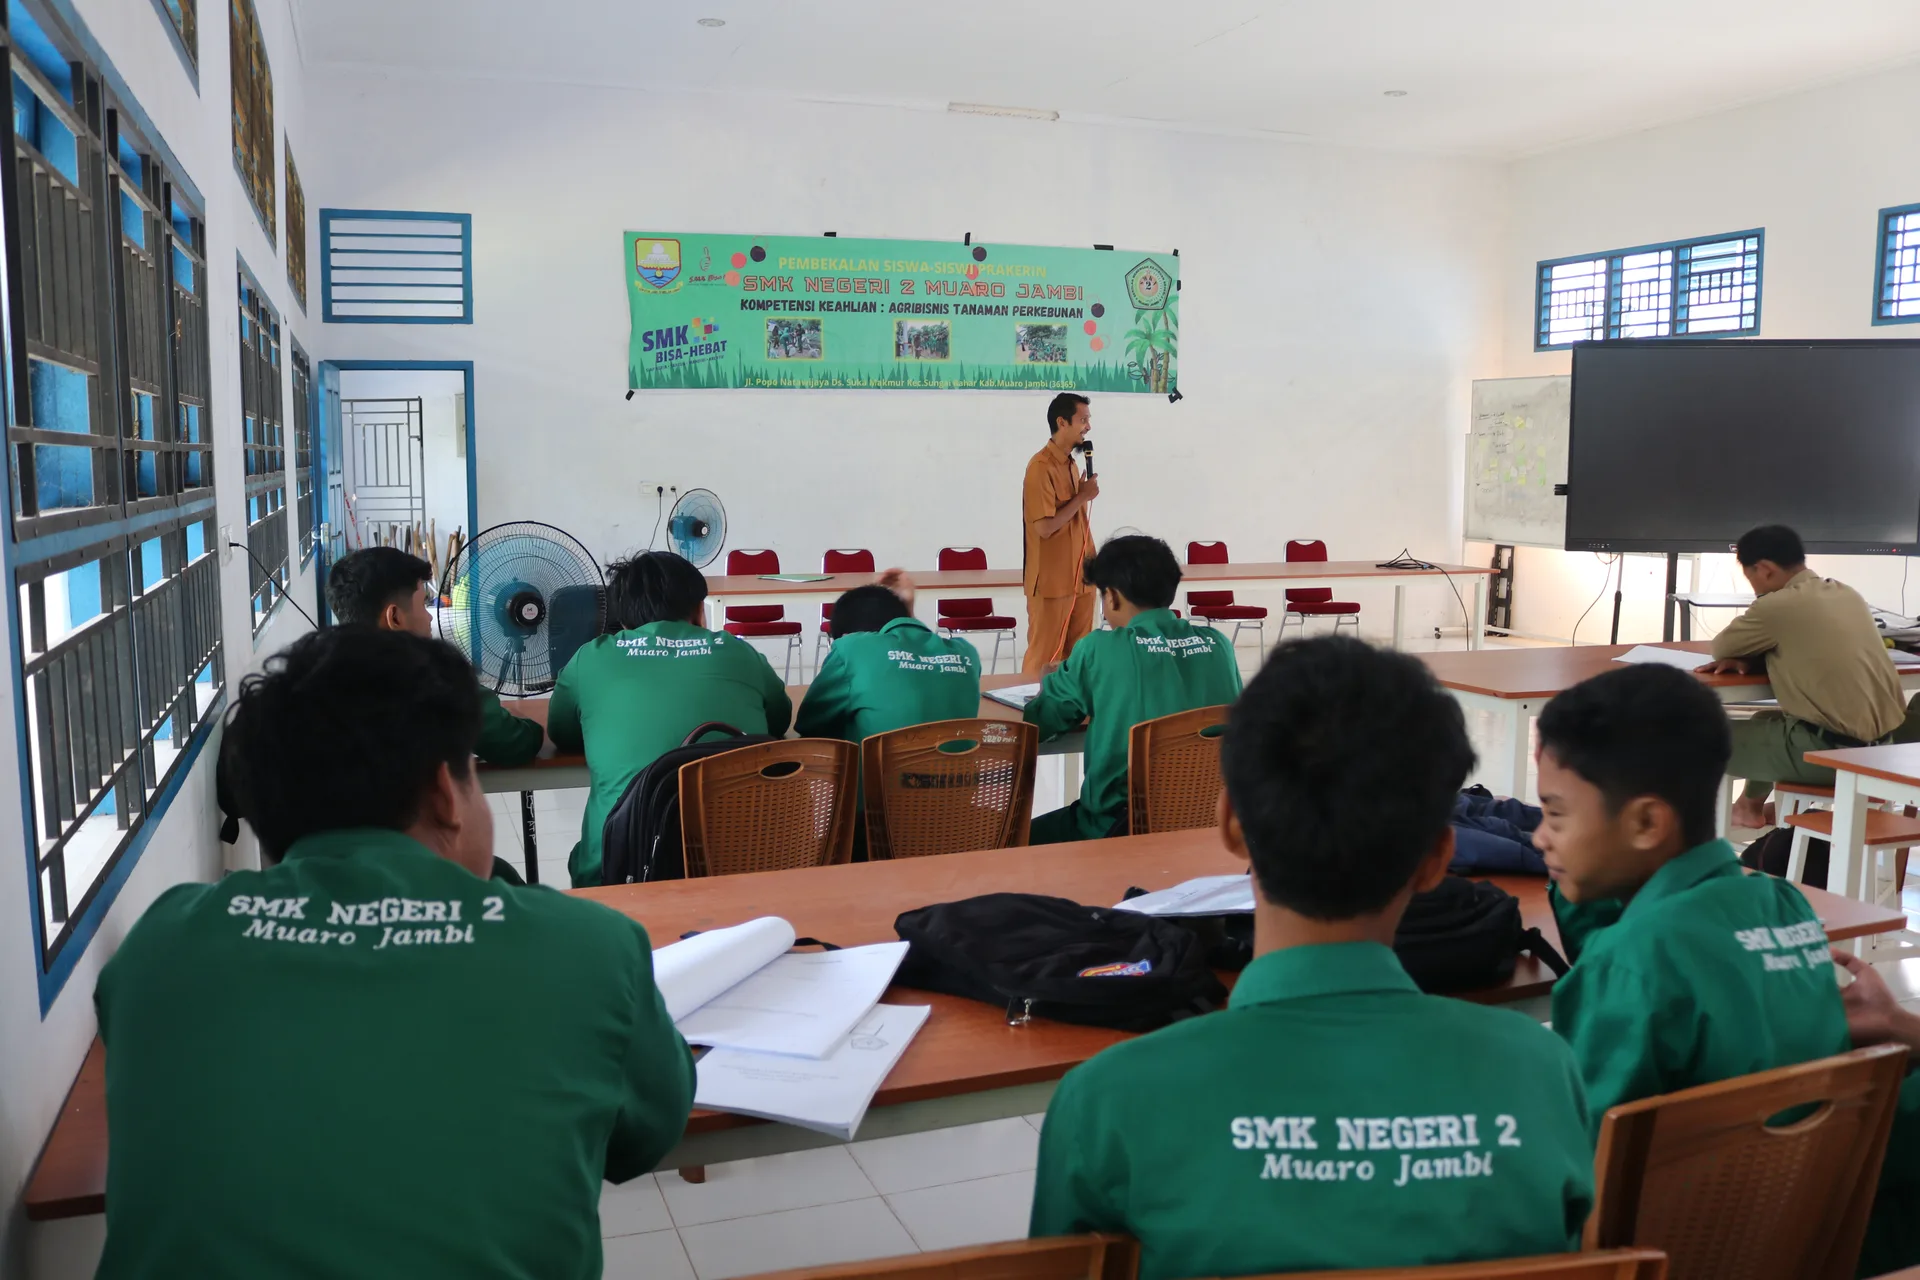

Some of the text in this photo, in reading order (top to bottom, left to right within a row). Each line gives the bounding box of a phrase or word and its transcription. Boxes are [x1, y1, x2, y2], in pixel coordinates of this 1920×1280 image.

[778, 257, 1047, 278] PEMBEKALAN SISWA-SISWI PRAKERIN
[743, 275, 1083, 301] SMK NEGERI 2 MUARO JAMBI
[740, 299, 815, 311] KOMPETENSI
[819, 301, 877, 313] KEAHLIAN
[889, 302, 949, 315] AGRIBISNIS
[953, 304, 1009, 317] TANAMAN
[1012, 305, 1083, 319] PERKEBUNAN
[642, 325, 689, 352] SMK
[655, 340, 727, 363] BISA-HEBAT
[745, 378, 754, 387] Jl.
[756, 378, 778, 388] Popo
[831, 378, 844, 387] Ds.
[847, 379, 867, 387] Suka
[869, 379, 904, 387] Makmur
[1024, 380, 1048, 389] Jambi
[616, 636, 724, 648] SMK NEGERI 2
[1136, 635, 1164, 645] SMK
[1206, 636, 1216, 645] 2
[626, 646, 712, 658] Muaro Jambi
[887, 650, 972, 666] SMK NEGERI 2
[1147, 645, 1212, 658] Muao Jambi
[898, 661, 967, 674] Muaro Jambi
[227, 895, 505, 926] SMK NEGERI 2
[242, 918, 475, 950] Muaro Jambi
[1230, 1114, 1521, 1150] SMK NEGERI 2
[1260, 1151, 1493, 1187] Muaro Jambi
